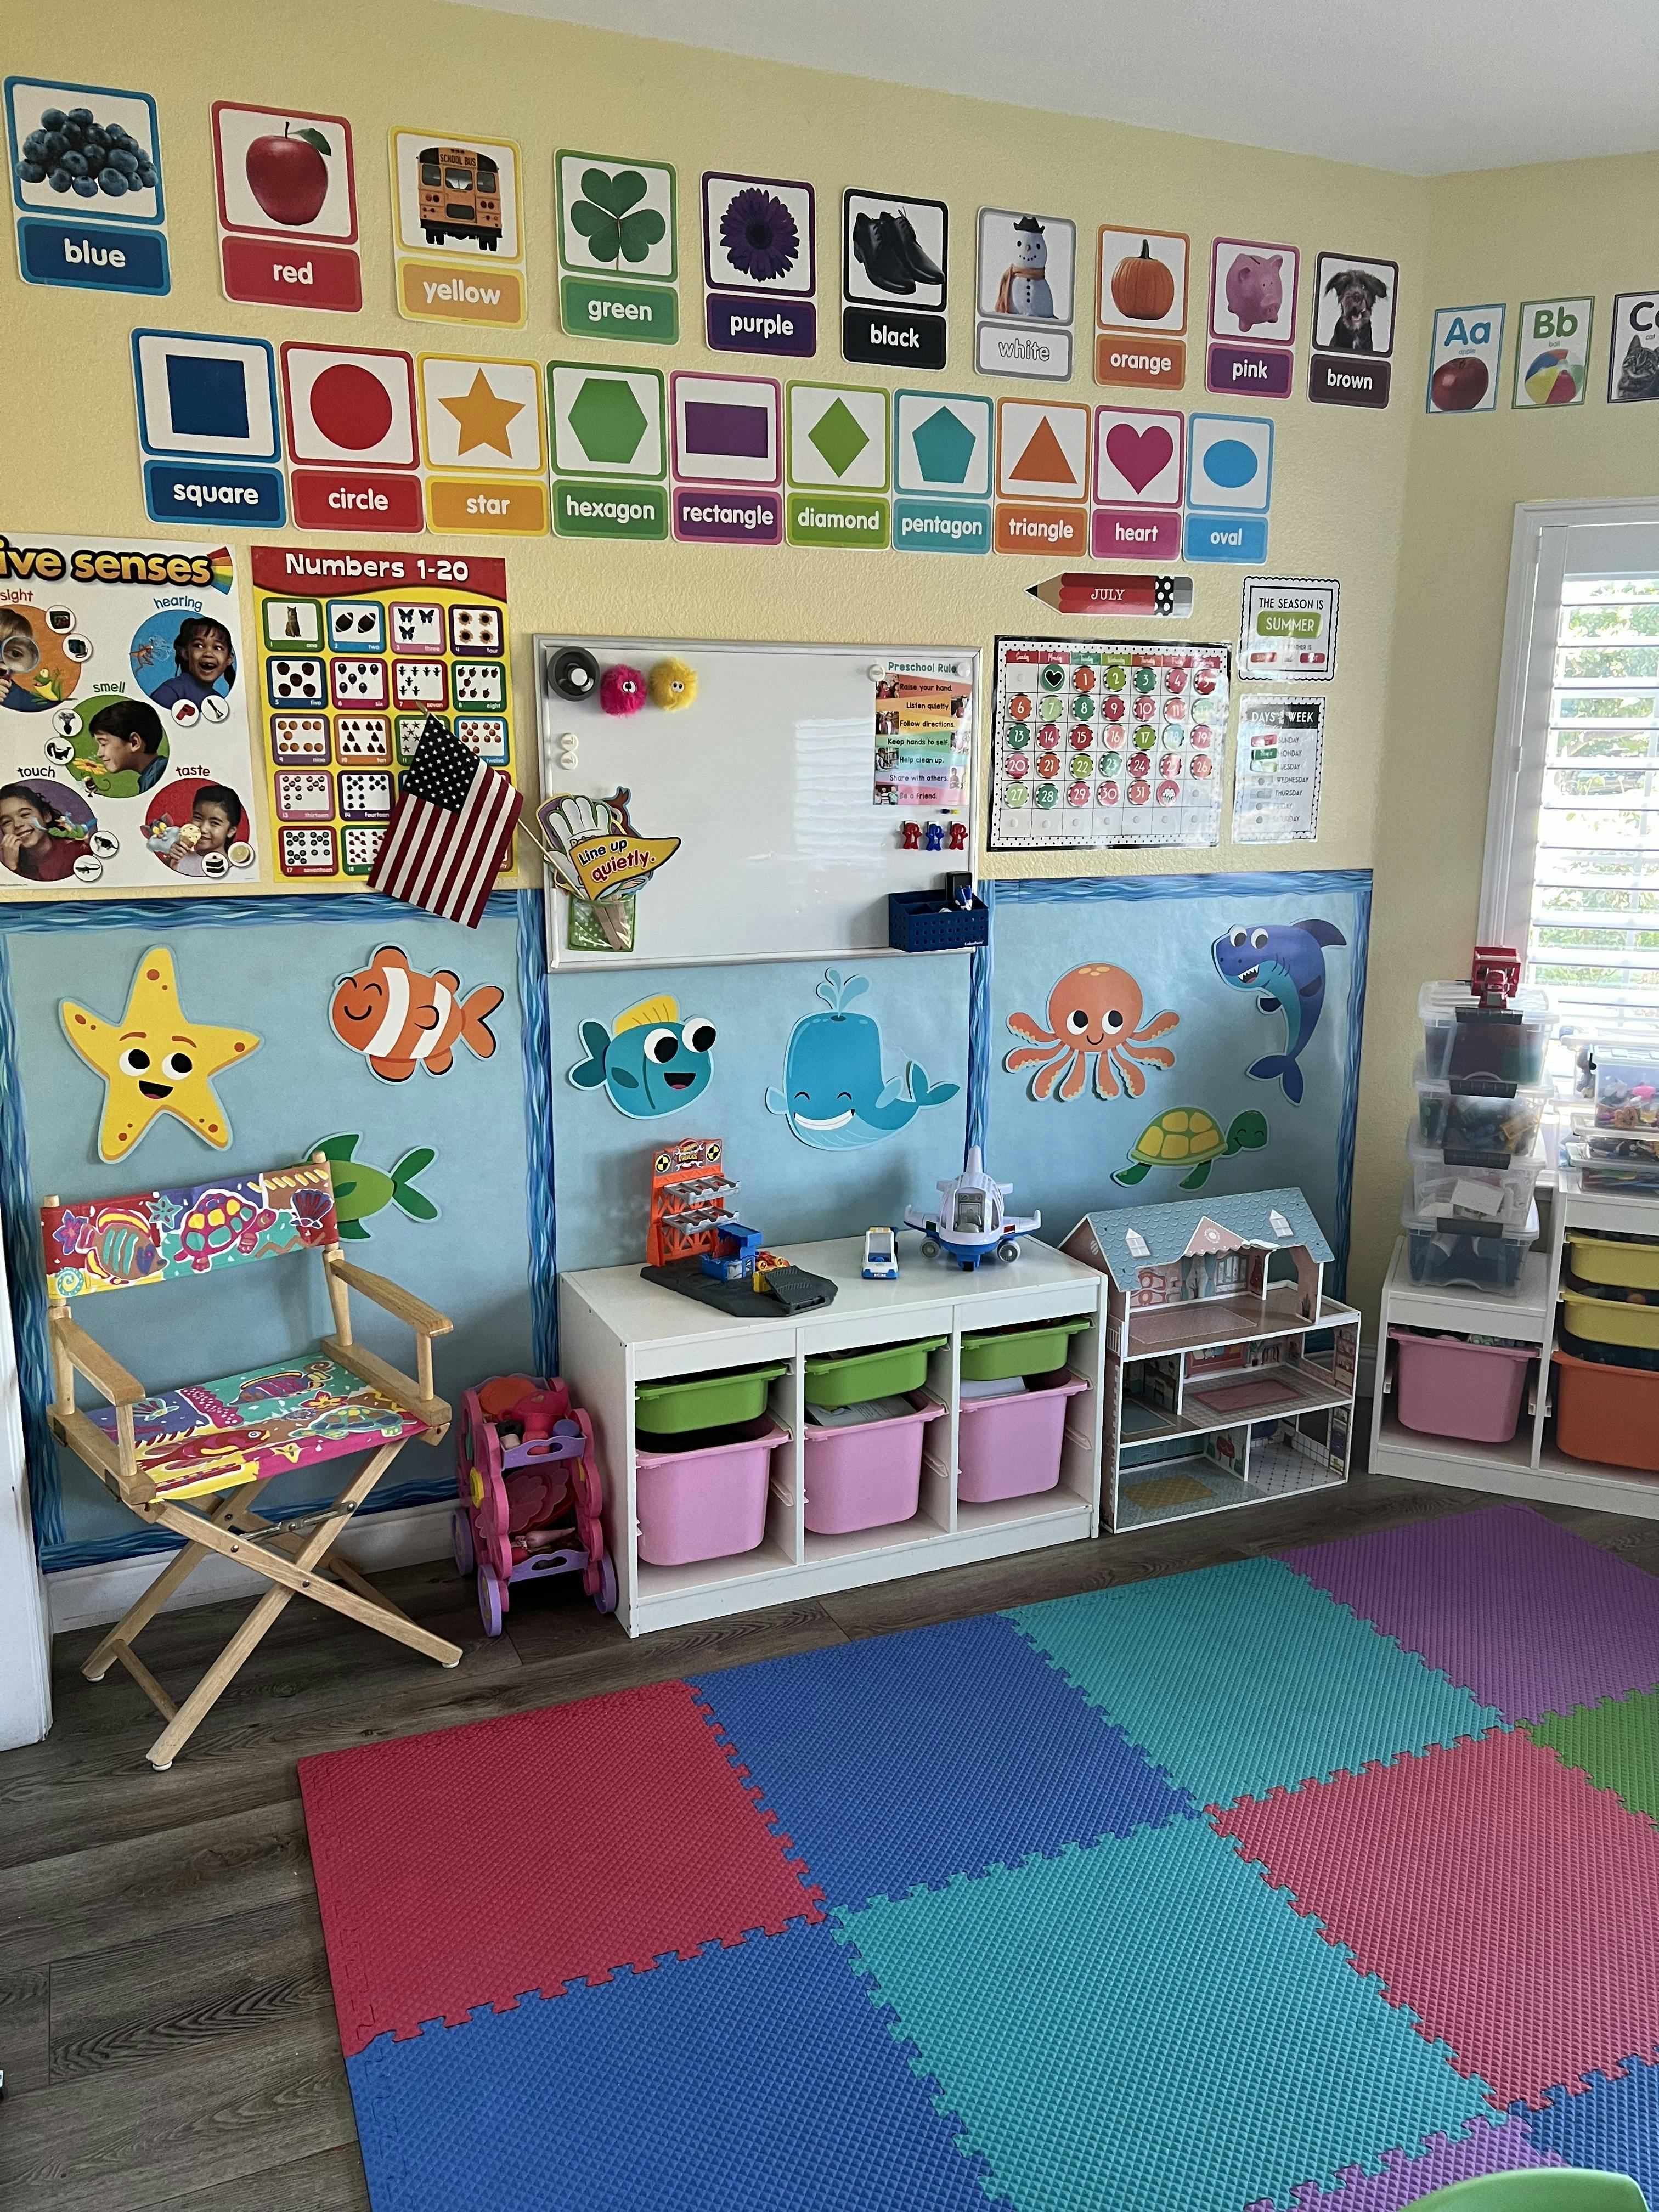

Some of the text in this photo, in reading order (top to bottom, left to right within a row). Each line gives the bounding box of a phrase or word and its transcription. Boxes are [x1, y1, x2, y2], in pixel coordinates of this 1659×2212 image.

[440, 154, 476, 166] SCHOOL BUS
[63, 238, 126, 268] blue
[273, 262, 313, 285] red
[422, 279, 501, 306] yellow
[588, 297, 652, 323] green
[1630, 301, 1659, 331] C
[731, 314, 793, 336] purple
[1533, 307, 1578, 340] Bb
[871, 324, 919, 348] black
[1444, 317, 1491, 346] Aa
[998, 338, 1050, 362] white
[1110, 353, 1171, 375] orange
[1232, 359, 1267, 380] pink
[1327, 368, 1373, 390] brown
[173, 482, 259, 506] square
[328, 487, 388, 511] circle
[466, 493, 510, 516] star
[566, 496, 655, 521] hexagon
[682, 505, 774, 529] rectangle
[798, 507, 879, 530] diamond
[902, 516, 983, 539] pentagon
[1009, 518, 1074, 539] triangle
[1115, 524, 1158, 543] heart
[1210, 528, 1242, 546] oval
[72, 551, 213, 586] senses
[285, 553, 469, 582] Numbers 1-20
[0, 588, 33, 603] sight
[1091, 588, 1125, 601] JULY
[154, 596, 202, 612] hearing
[1259, 597, 1324, 610] THE SEASON IS
[1266, 617, 1314, 631] SUMMER
[888, 662, 958, 674] Preschool Rule
[1083, 673, 1088, 685] 1
[1112, 673, 1120, 685] 2
[1142, 674, 1149, 686] 3
[1175, 676, 1180, 687] 4
[93, 681, 126, 693] smell
[1017, 702, 1024, 713] 6
[1048, 703, 1054, 715] 7
[1081, 702, 1088, 714] 8
[1110, 702, 1118, 714] 9
[1138, 703, 1152, 714] 10
[1172, 705, 1180, 716] 11
[1251, 712, 1276, 723] DAYS
[1288, 712, 1314, 723] WEEK
[1014, 730, 1024, 742] 13
[1045, 731, 1054, 743] 14
[1077, 731, 1087, 743] 15
[1111, 731, 1120, 742] 16
[1141, 732, 1150, 744] 17
[1198, 732, 1207, 744] 19
[1009, 760, 1025, 772] 20
[1044, 760, 1054, 771] 21
[1076, 761, 1088, 773] 22
[1107, 758, 1117, 768] 23
[1133, 760, 1145, 772] 24
[1197, 761, 1207, 772] 26
[17, 766, 55, 778] touch
[176, 766, 210, 777] taste
[1011, 789, 1023, 801] 27
[1041, 791, 1053, 802] 28
[1074, 789, 1086, 800] 29
[1102, 787, 1117, 800] 30
[1136, 787, 1144, 798] 31
[578, 845, 606, 865] Line
[610, 839, 627, 853] up
[592, 850, 656, 882] quietly.
